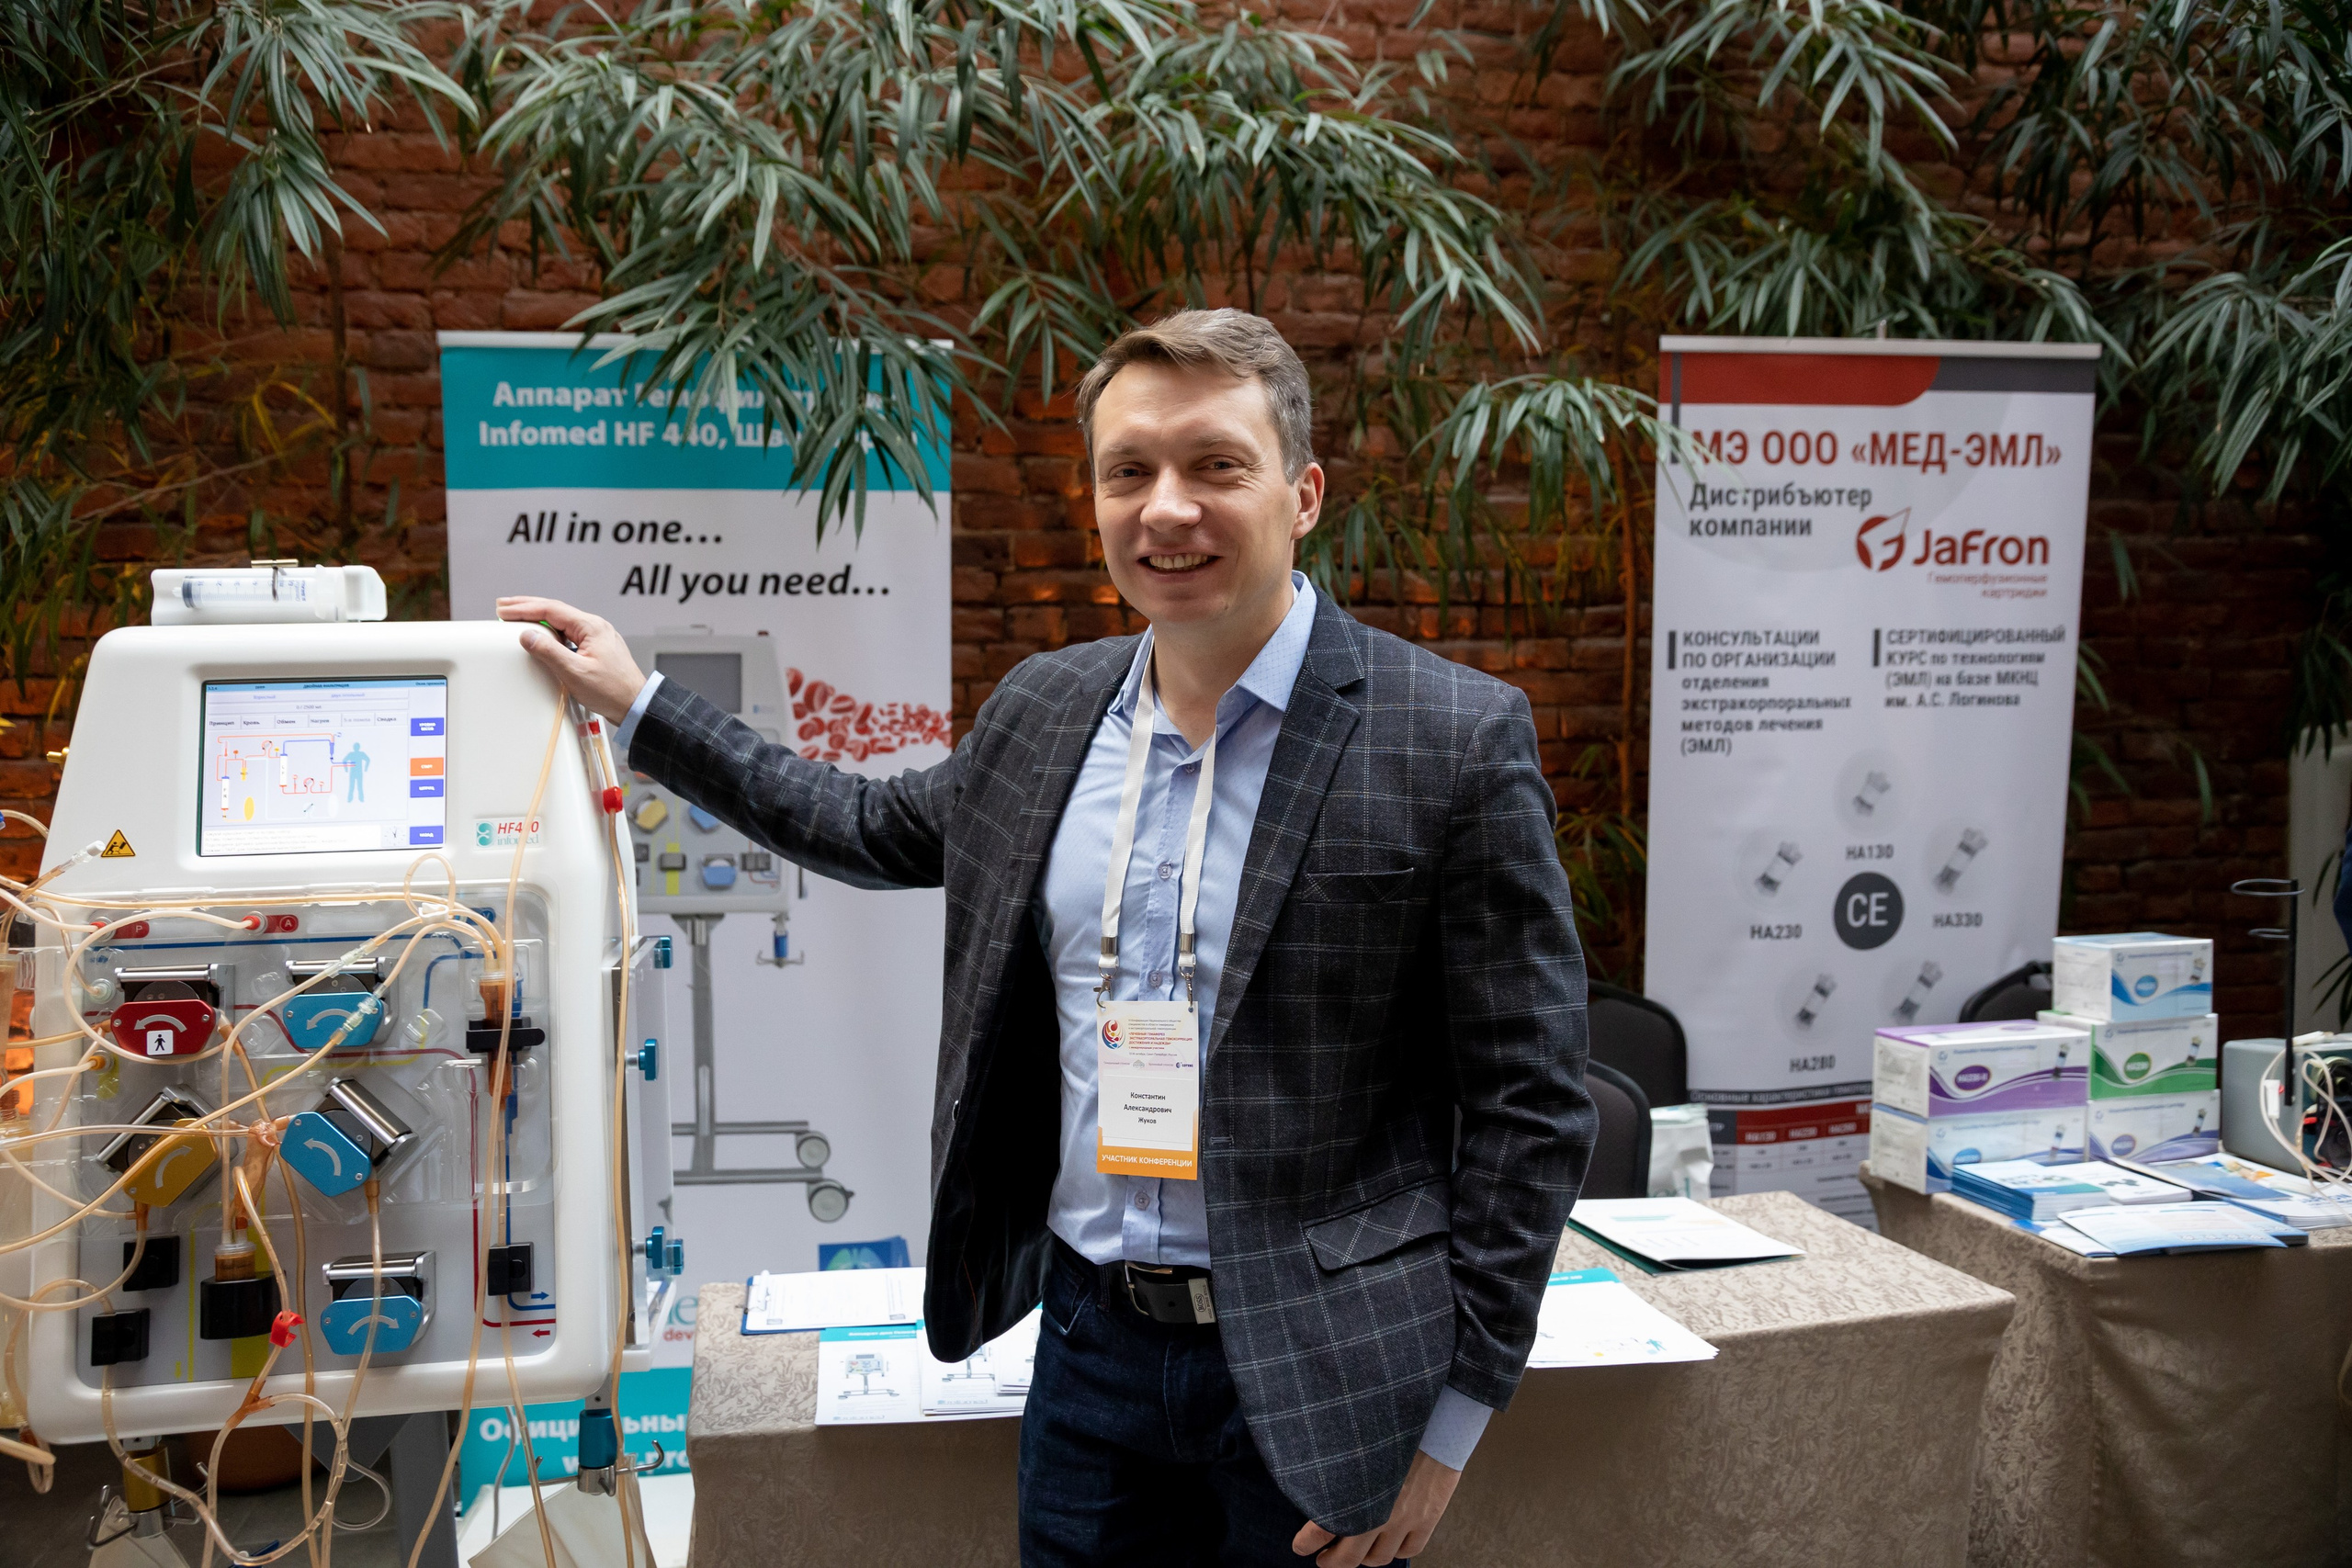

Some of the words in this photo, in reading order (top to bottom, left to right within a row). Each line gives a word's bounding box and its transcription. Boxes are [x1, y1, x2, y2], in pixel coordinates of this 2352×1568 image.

[492, 382, 626, 412] Аппарат
[480, 421, 607, 446] Infomed
[615, 422, 654, 446] HF
[1762, 430, 1838, 465] ООО
[1850, 432, 2061, 474] «МЕД-ЭМЛ»
[1690, 482, 1871, 512] Дистрибъютер
[507, 512, 556, 544] All
[566, 512, 600, 544] in
[612, 520, 723, 544] one...
[1690, 517, 1812, 537] компании
[1912, 527, 2051, 566] JaFron
[620, 564, 672, 595] All
[678, 571, 749, 604] you
[760, 564, 890, 596] need...
[1682, 630, 1820, 648] КОНСУЛЬТАЦИИ
[1886, 626, 2066, 647] СЕРТИФИЦИРОВАННЫЙ
[1682, 652, 1706, 668] ПО
[1712, 650, 1837, 669] ОРГАНИЗАЦИИ
[1886, 650, 1928, 666] КУРС
[1681, 675, 1770, 691] отделения
[1956, 671, 1991, 686] базе
[1680, 696, 1851, 713] экстракорпоральных
[1680, 718, 1753, 734] методов
[1758, 716, 1823, 732] лечения
[1680, 738, 1733, 757] (ЭМЛ)
[497, 821, 539, 835] HF40
[497, 834, 539, 847] infoed
[1845, 844, 1894, 860] HA130
[1846, 892, 1889, 928] CE
[284, 919, 292, 928] A
[1933, 912, 1983, 928] HA330
[135, 925, 143, 933] P
[1750, 924, 1802, 940] HA230
[1130, 1092, 1166, 1101] Константин
[1124, 1104, 1172, 1114] Александрович
[1137, 1117, 1157, 1125] Жуков
[1102, 1154, 1137, 1164] УЧАСТНИК
[1139, 1156, 1193, 1168] КОНФЕРЕНЦИИ
